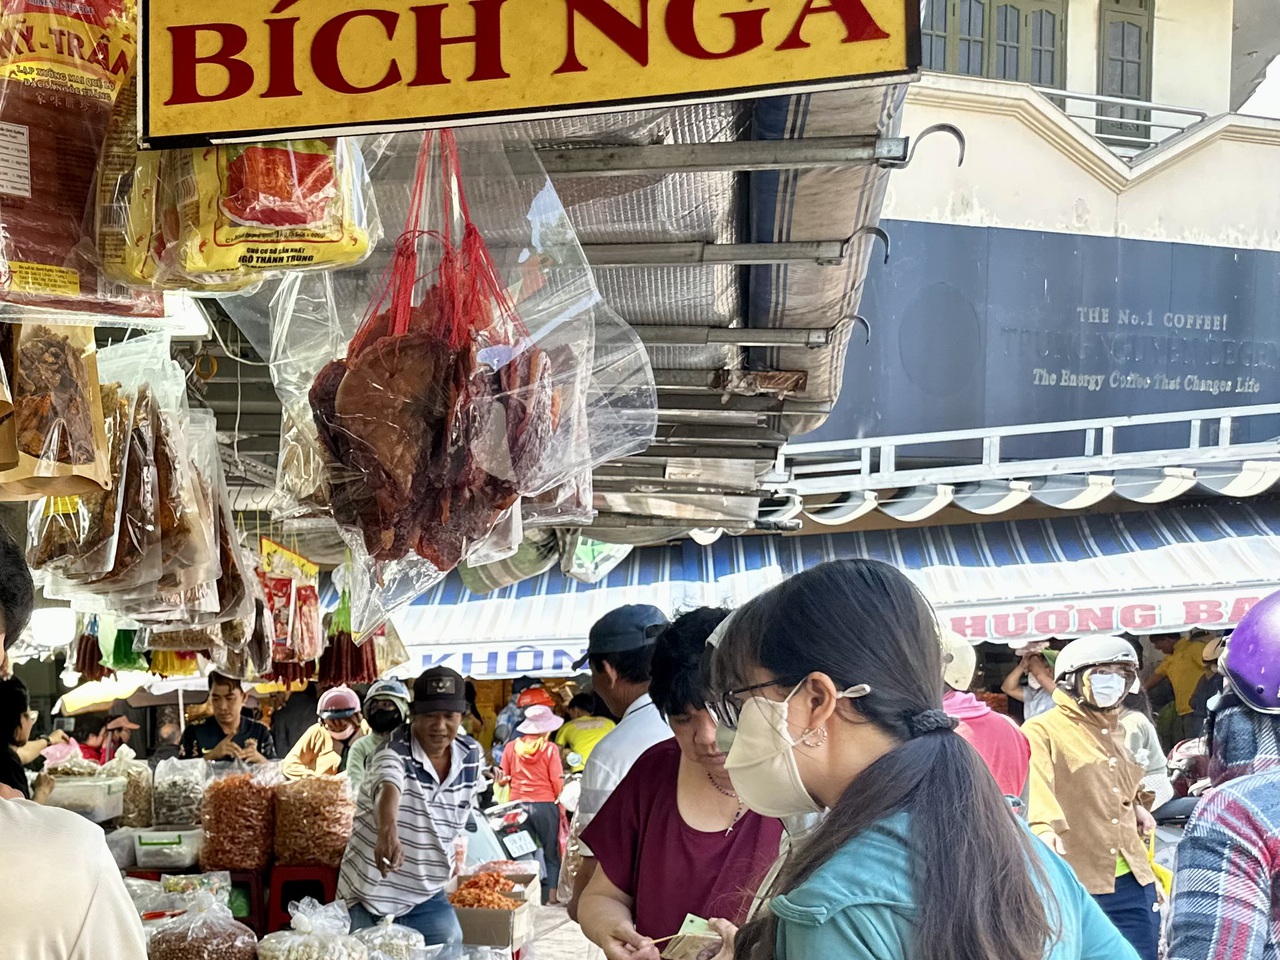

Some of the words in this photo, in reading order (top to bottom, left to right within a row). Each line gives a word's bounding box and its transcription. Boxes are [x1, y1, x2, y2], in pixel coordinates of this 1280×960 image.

[163, 0, 511, 106] BÍCH
[554, 0, 890, 75] NGA
[1076, 307, 1110, 324] THE
[1032, 368, 1057, 386] The
[1060, 370, 1104, 391] Energy
